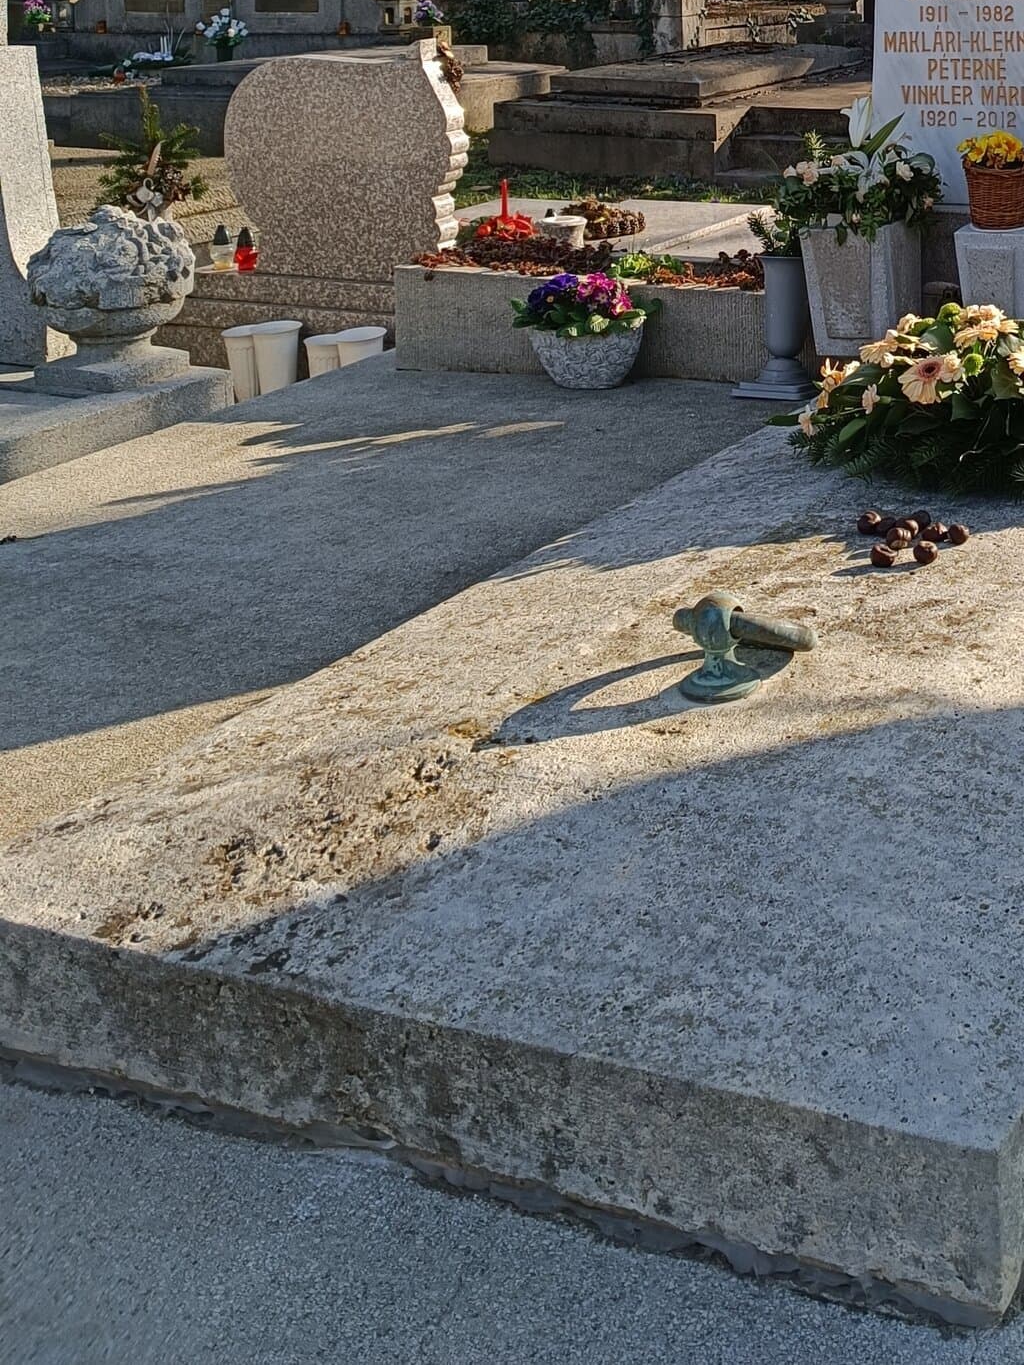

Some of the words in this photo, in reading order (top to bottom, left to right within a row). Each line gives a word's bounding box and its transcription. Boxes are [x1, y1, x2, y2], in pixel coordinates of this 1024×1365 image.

[919, 6, 948, 22] 1911
[976, 5, 1015, 22] 1982
[927, 53, 1007, 81] PÉTERNÉ
[901, 85, 973, 105] VINKLER
[920, 110, 957, 127] 1920
[977, 111, 1017, 129] 2012
